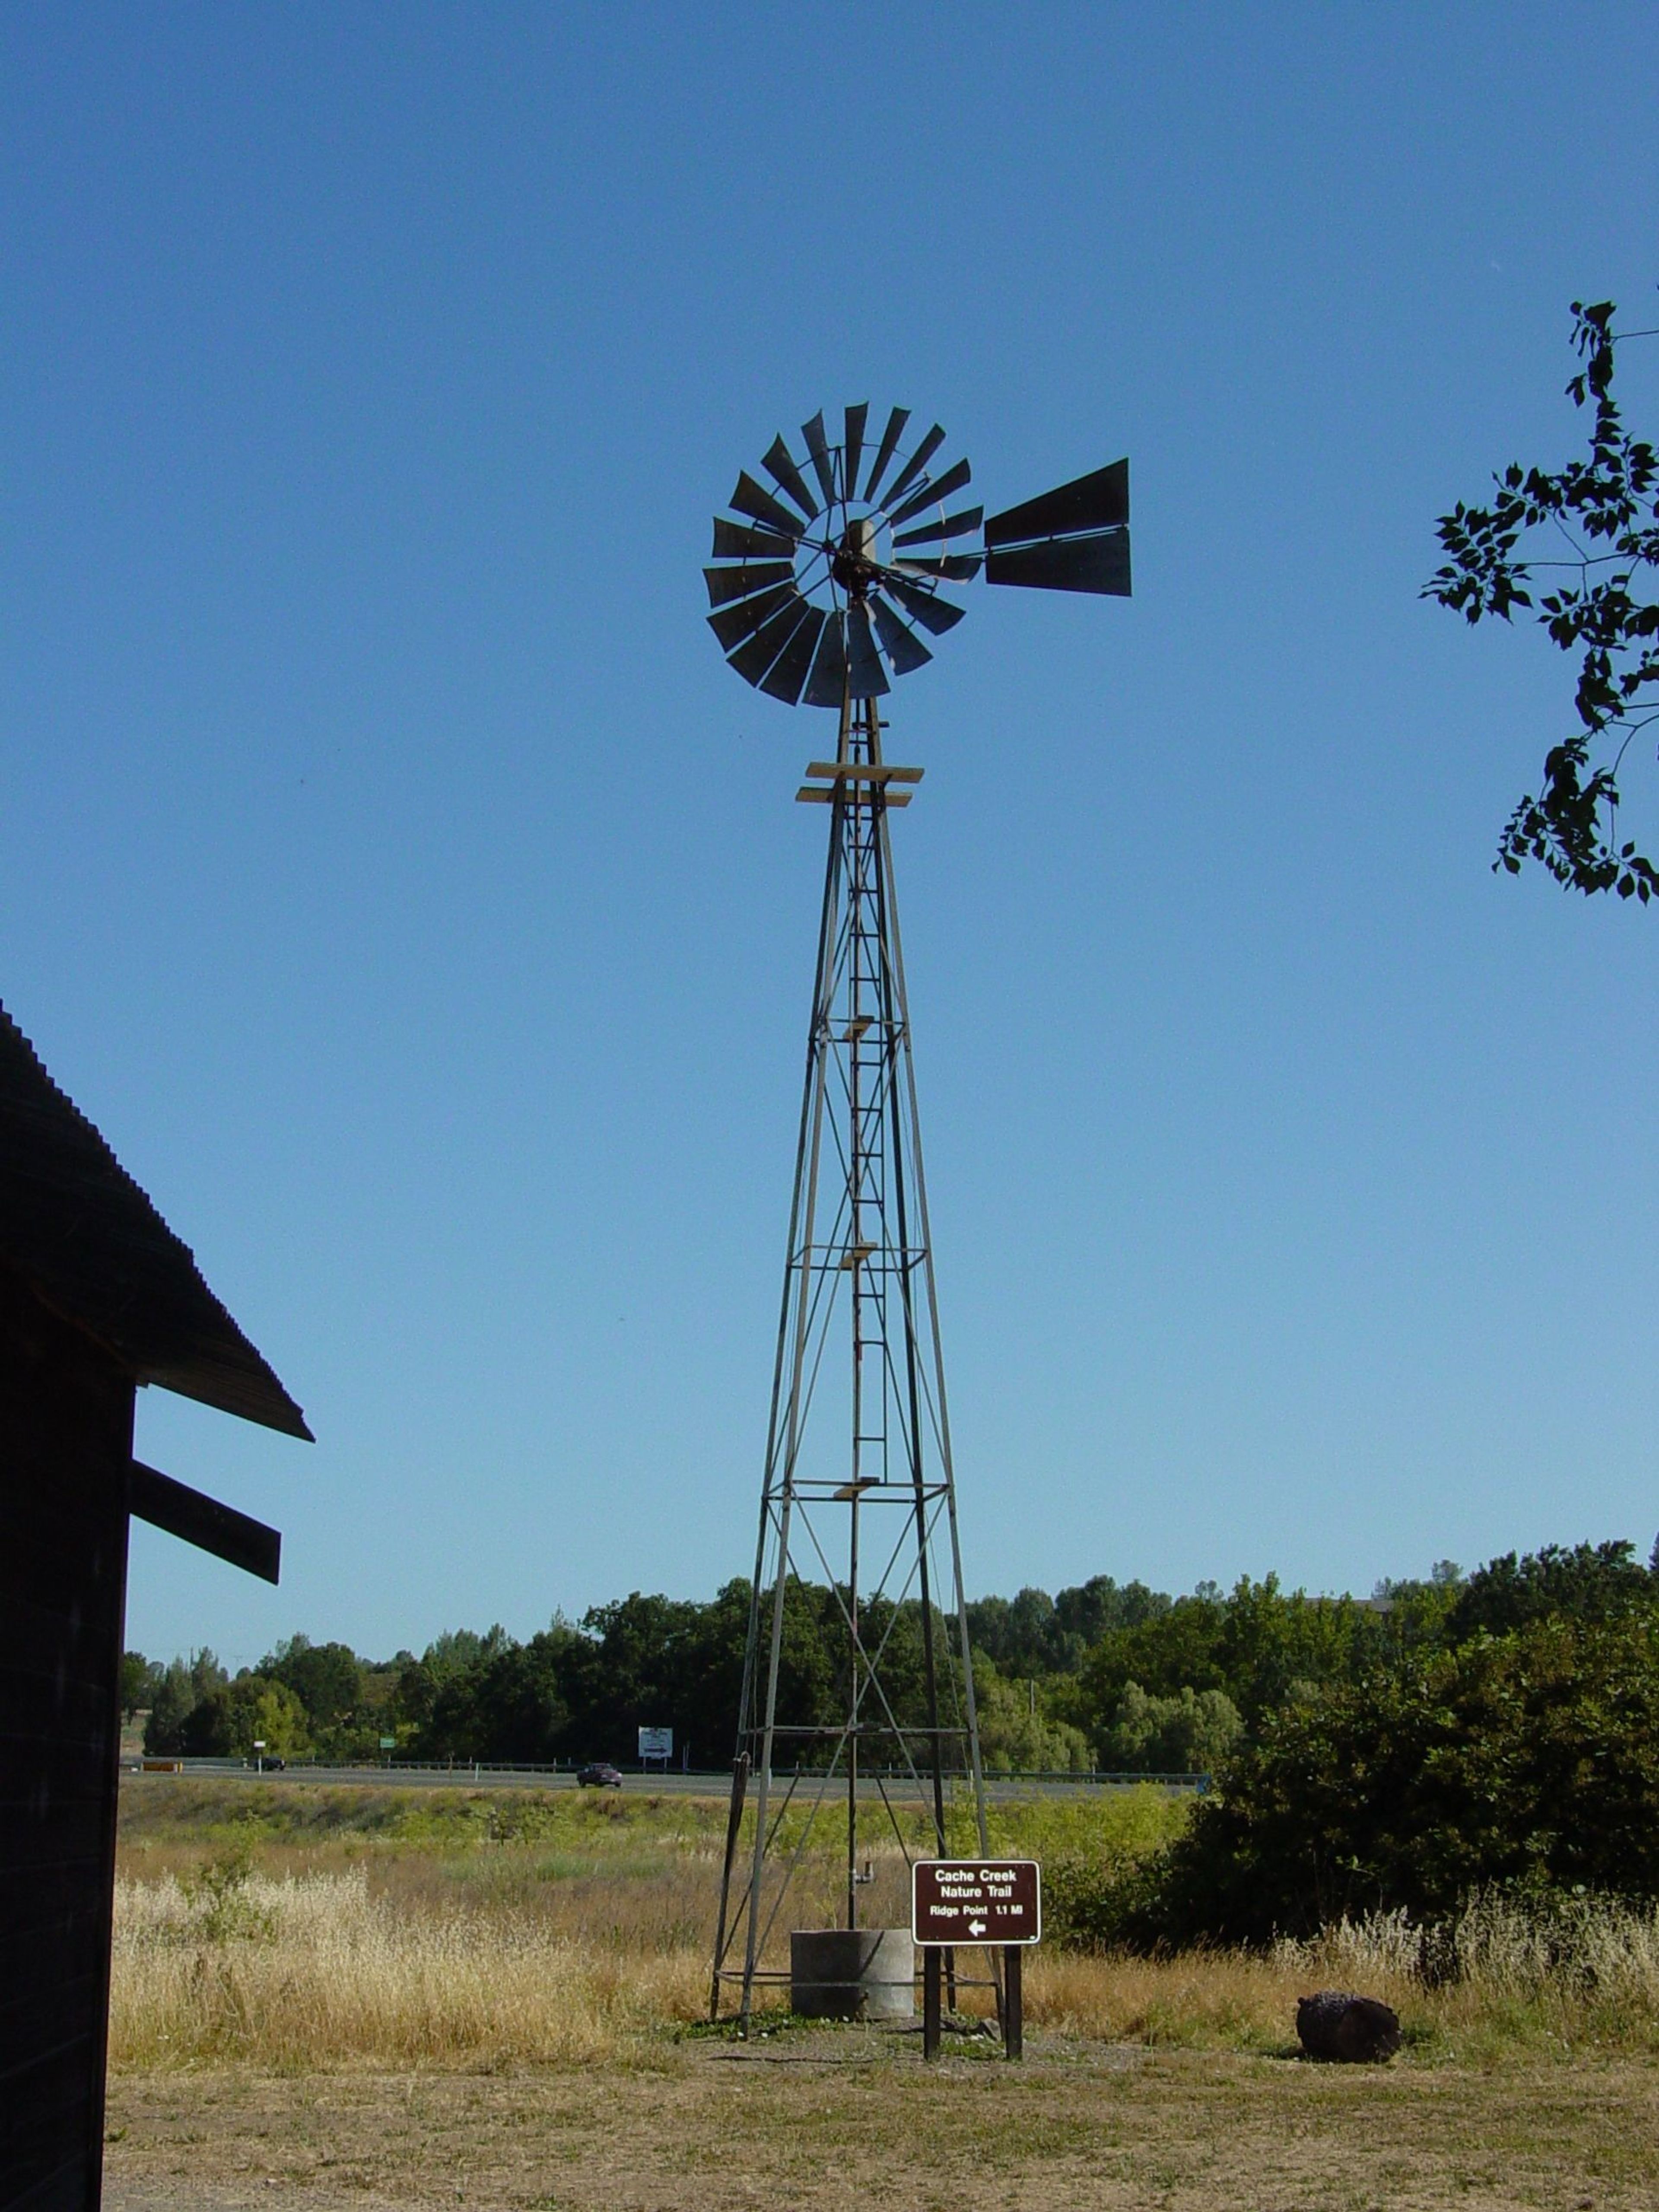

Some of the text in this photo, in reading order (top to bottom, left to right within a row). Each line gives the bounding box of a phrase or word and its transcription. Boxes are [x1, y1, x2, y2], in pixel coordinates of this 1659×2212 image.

[935, 1869, 1017, 1882] Cache Creek
[941, 1885, 1011, 1898] Nature Trail
[930, 1905, 959, 1917] Ridge
[963, 1905, 988, 1916] Point
[995, 1905, 1007, 1915] 1.1
